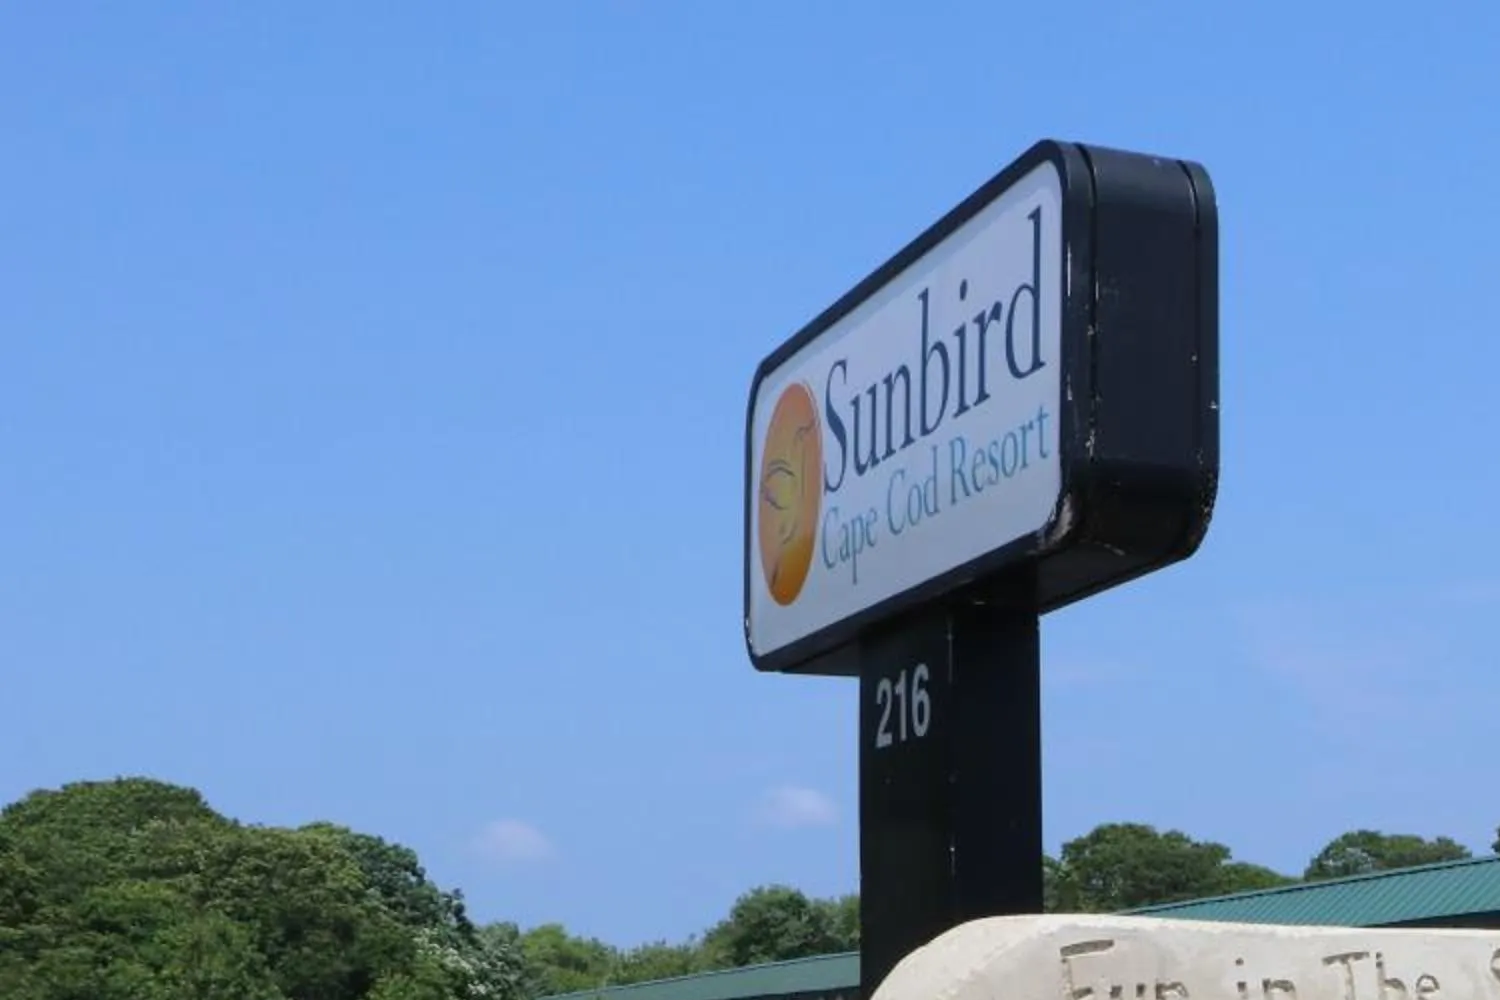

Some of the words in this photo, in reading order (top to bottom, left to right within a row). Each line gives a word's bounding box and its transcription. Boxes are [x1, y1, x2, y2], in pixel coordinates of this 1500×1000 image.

[822, 204, 1047, 496] Sunbird
[820, 506, 877, 585] Cape
[887, 445, 940, 536] Cod
[949, 404, 1051, 507] Resort
[875, 661, 931, 749] 216
